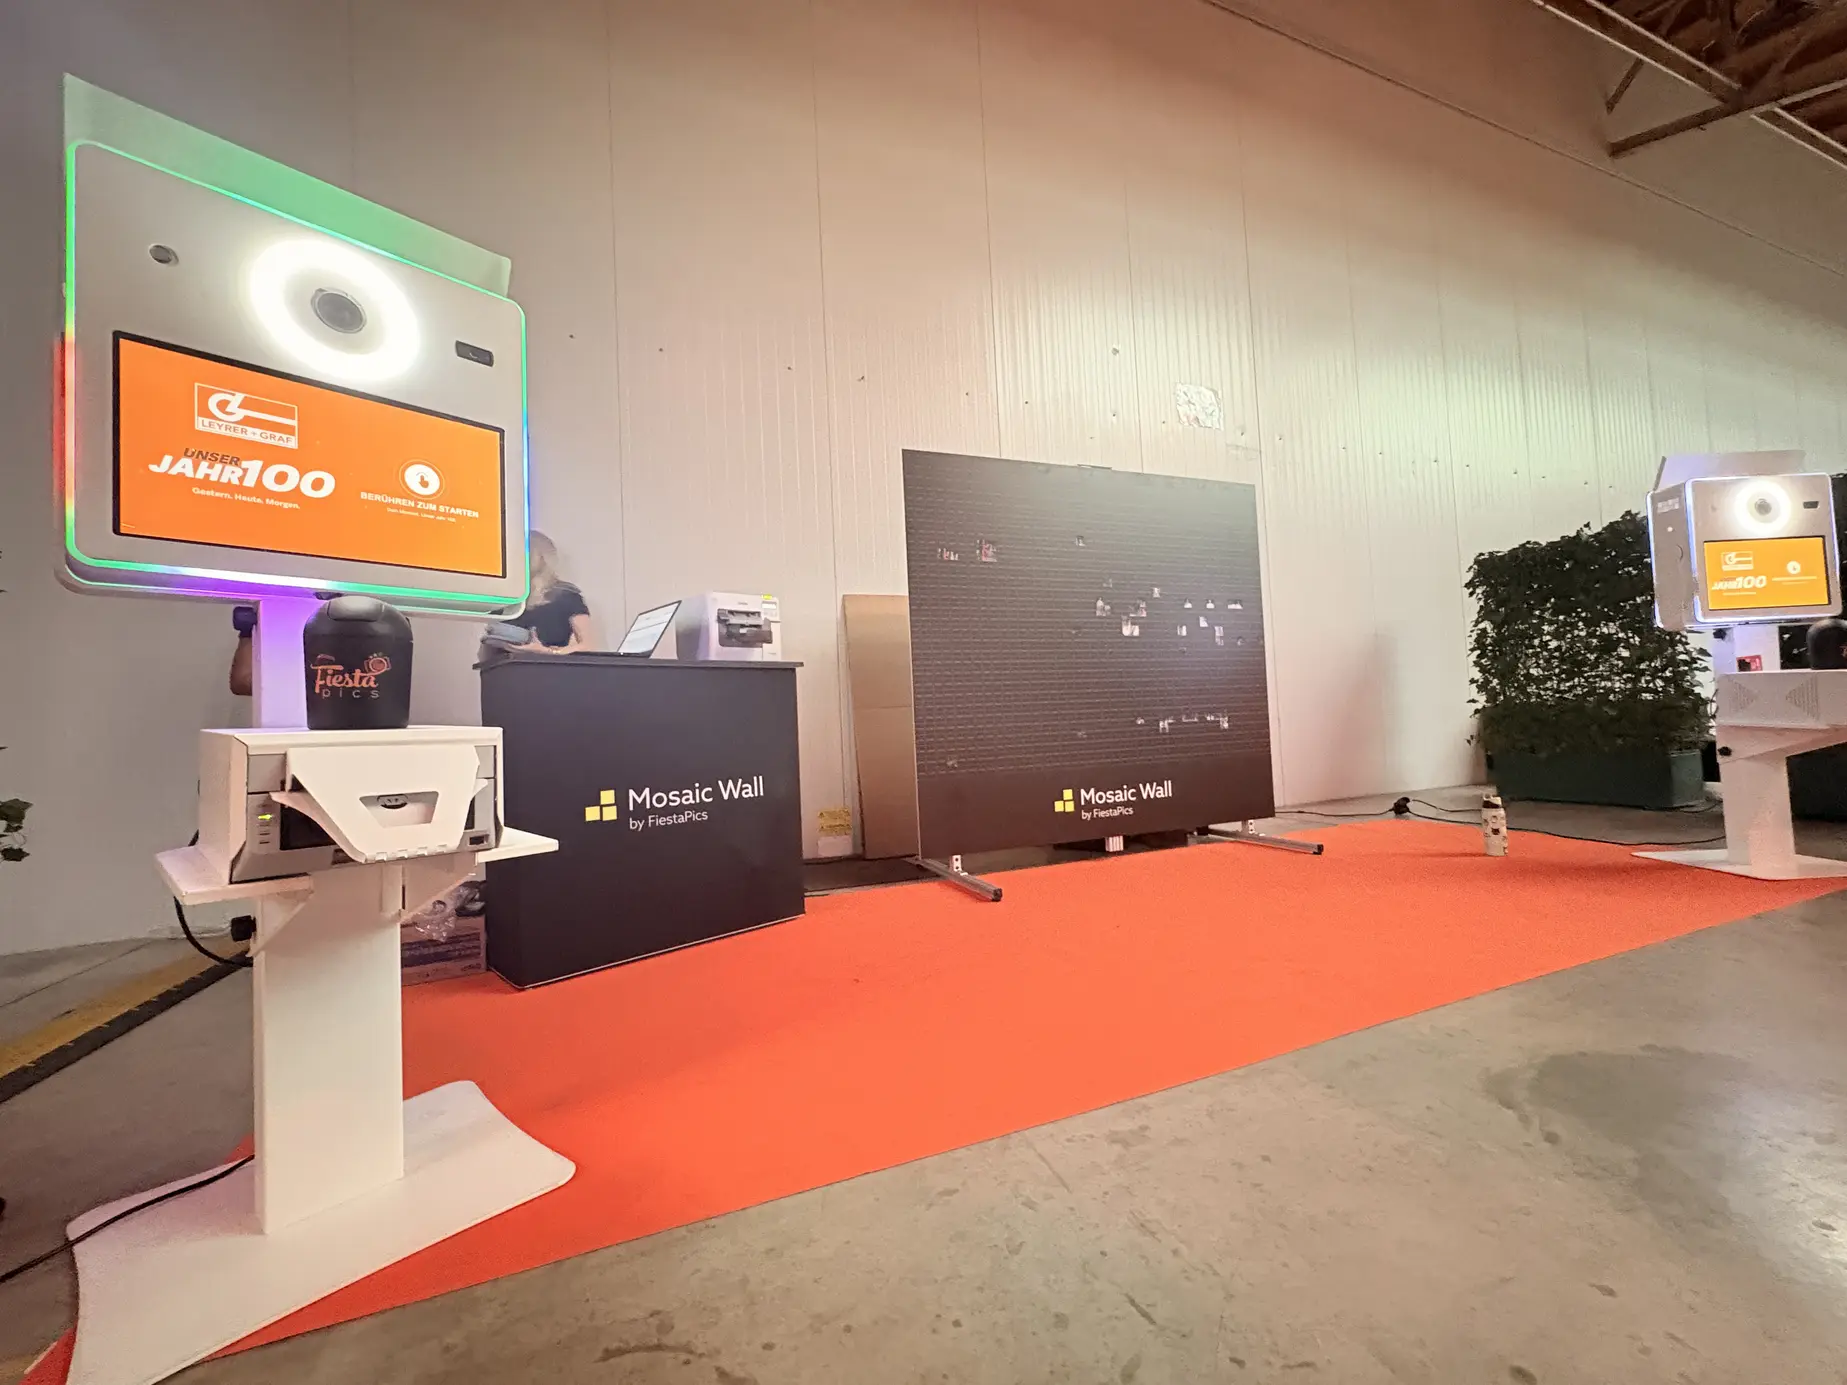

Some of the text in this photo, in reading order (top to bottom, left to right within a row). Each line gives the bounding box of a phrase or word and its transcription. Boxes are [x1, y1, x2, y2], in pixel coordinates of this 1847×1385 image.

[201, 419, 248, 436] LEYRER
[259, 431, 293, 444] GRAF
[183, 447, 241, 467] UNSER
[192, 487, 233, 500] Gestern.
[360, 491, 415, 508] BERÜHREN
[416, 501, 437, 511] ZUM
[438, 505, 480, 518] STARTEN
[310, 663, 379, 694] Fiesta
[628, 775, 765, 811] Mosaic Wall
[1080, 780, 1173, 805] Mosaic Wall
[629, 809, 709, 831] by FiestaPics
[1081, 806, 1134, 820] by FiestaPics
